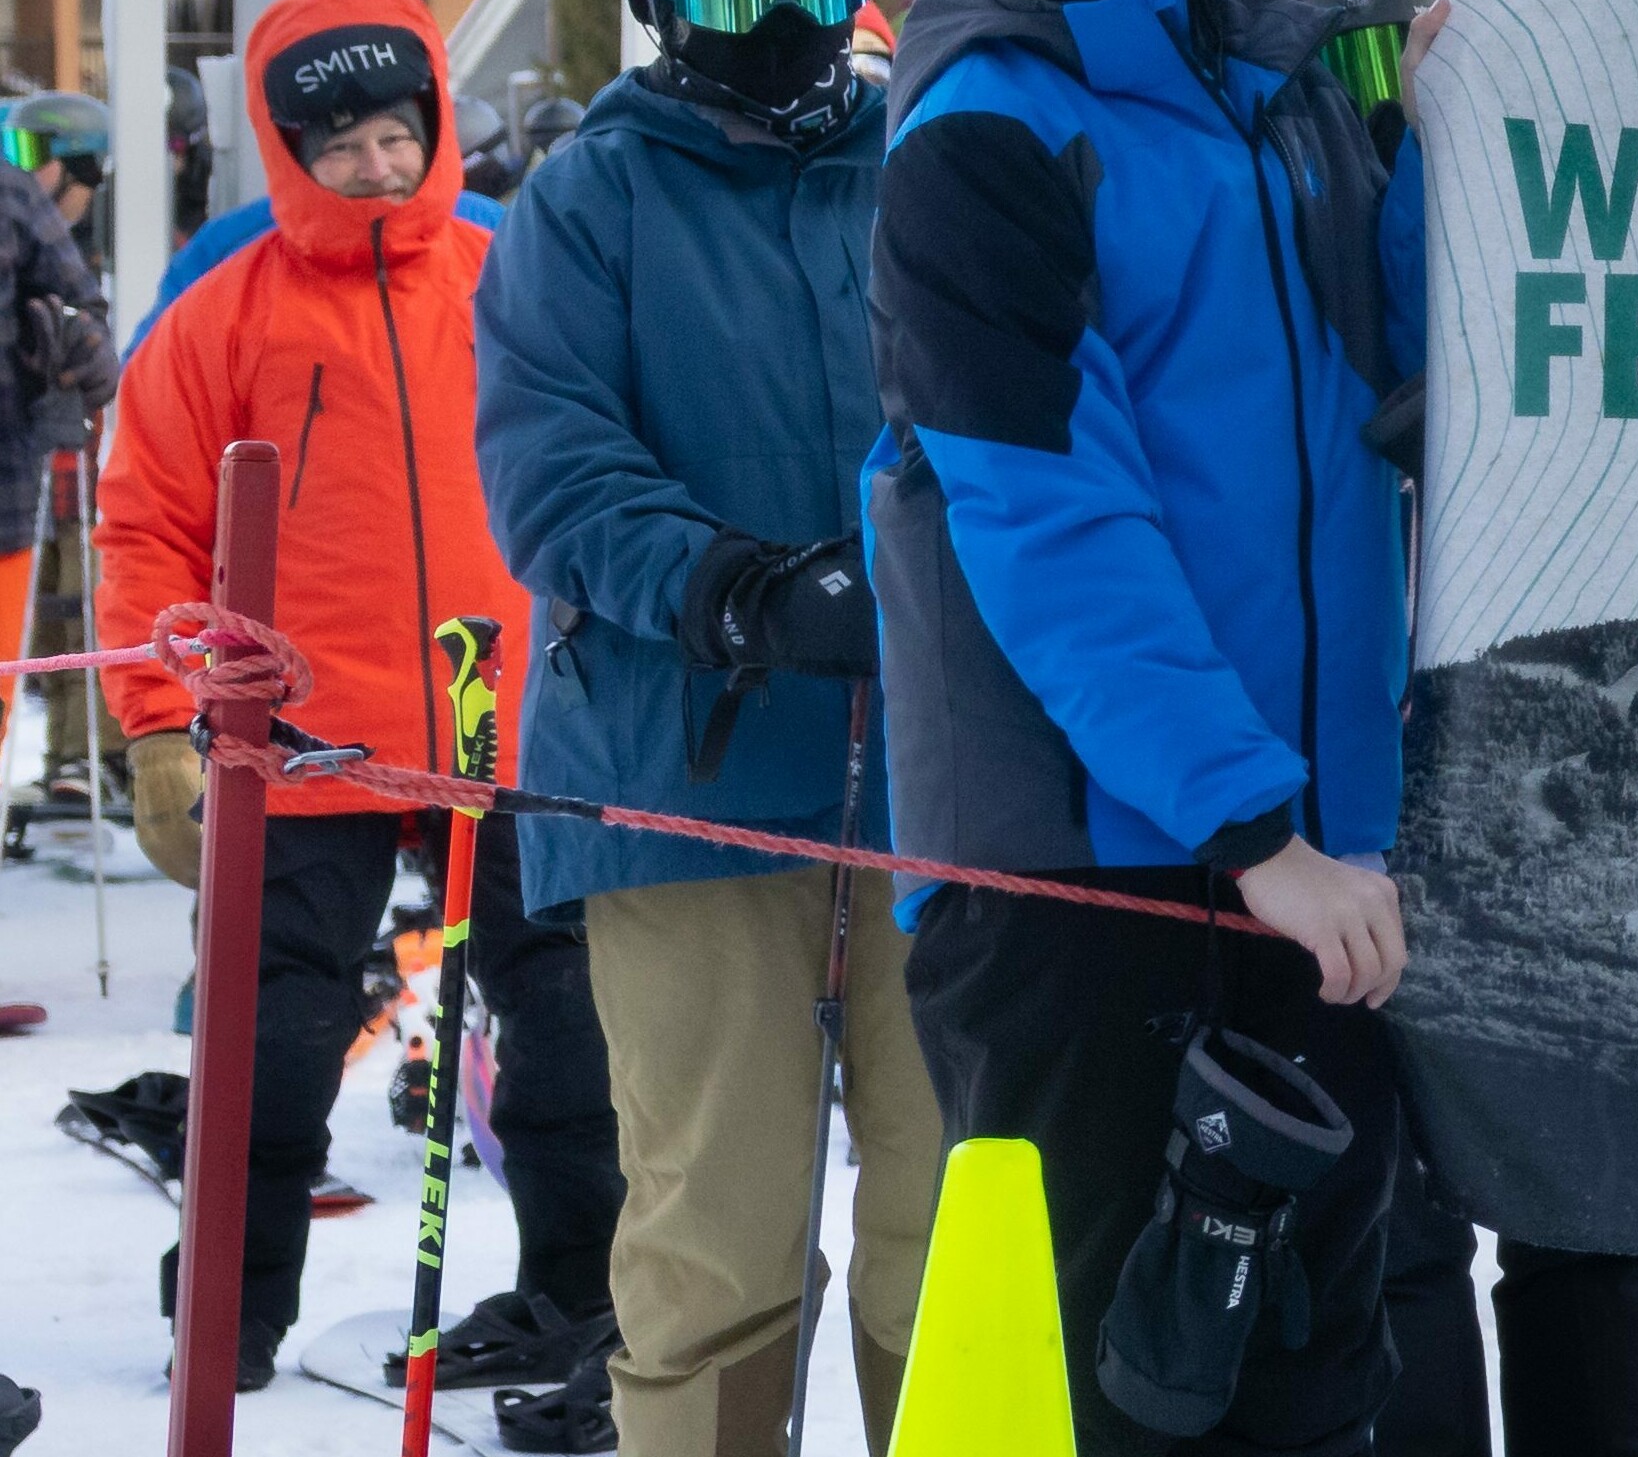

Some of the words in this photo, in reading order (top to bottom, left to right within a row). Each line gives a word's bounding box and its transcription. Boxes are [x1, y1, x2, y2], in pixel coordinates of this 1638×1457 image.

[294, 42, 398, 94] SMITH
[467, 734, 486, 778] LEKI
[417, 1137, 449, 1270] LEKI
[1203, 1215, 1257, 1246] EKI
[1226, 1254, 1251, 1310] HESTRA
